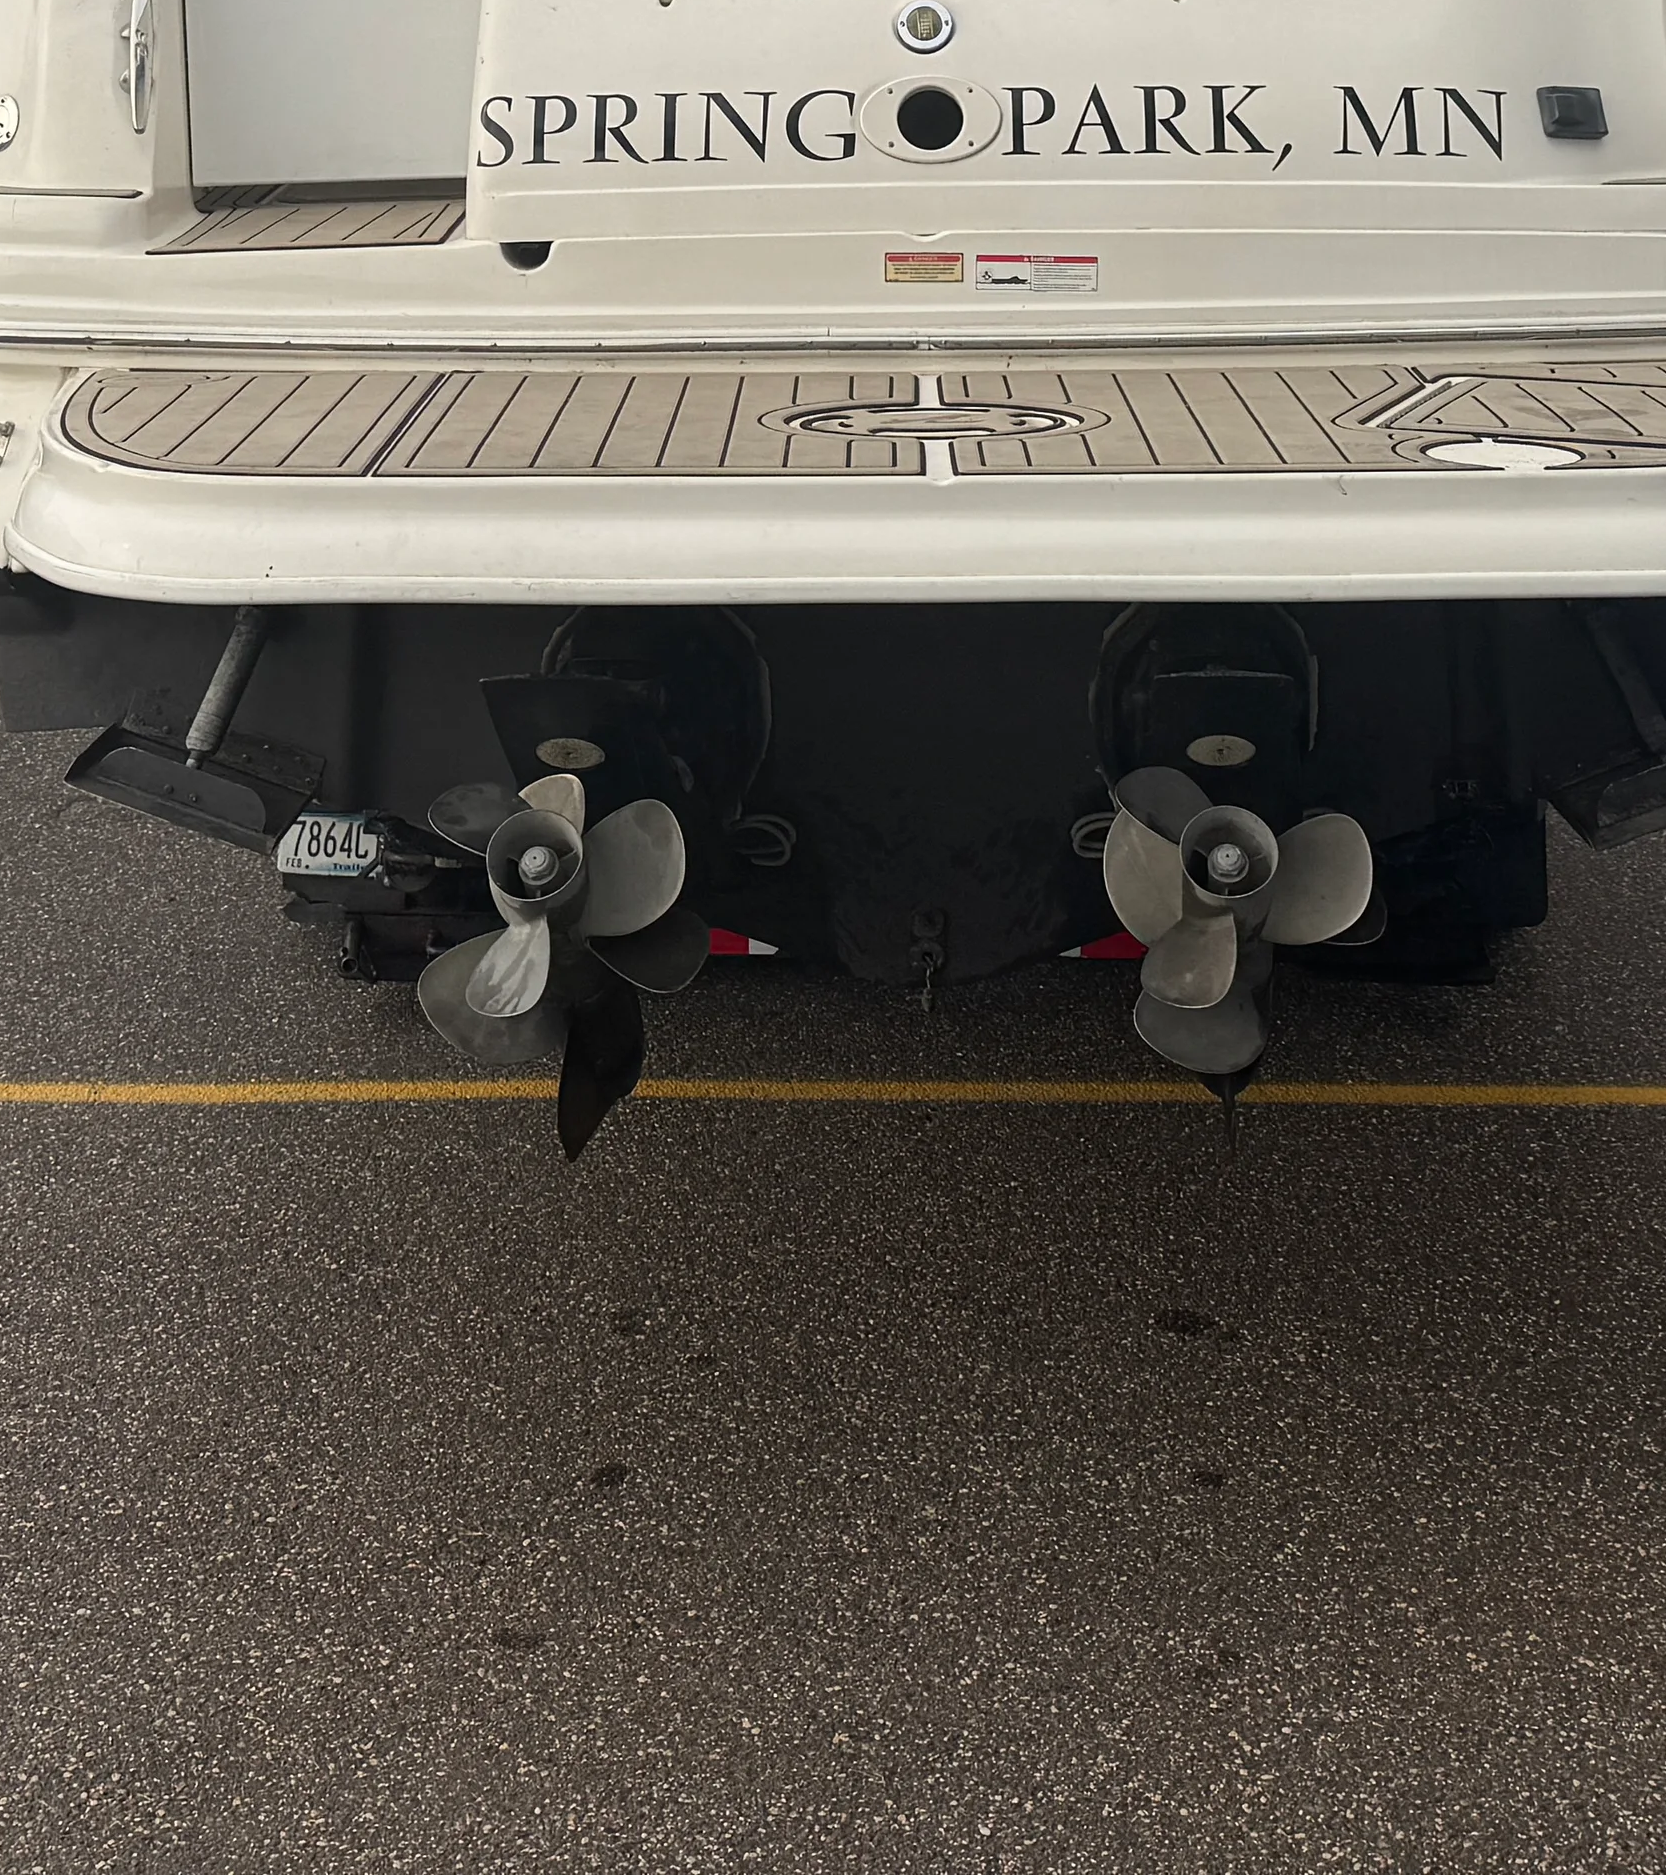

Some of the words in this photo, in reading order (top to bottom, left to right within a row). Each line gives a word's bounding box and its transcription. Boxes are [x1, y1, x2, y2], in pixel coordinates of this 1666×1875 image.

[476, 88, 858, 168] SPRING
[1000, 82, 1294, 172] PARK,
[1332, 85, 1508, 162] MN
[333, 862, 365, 872] Trail
